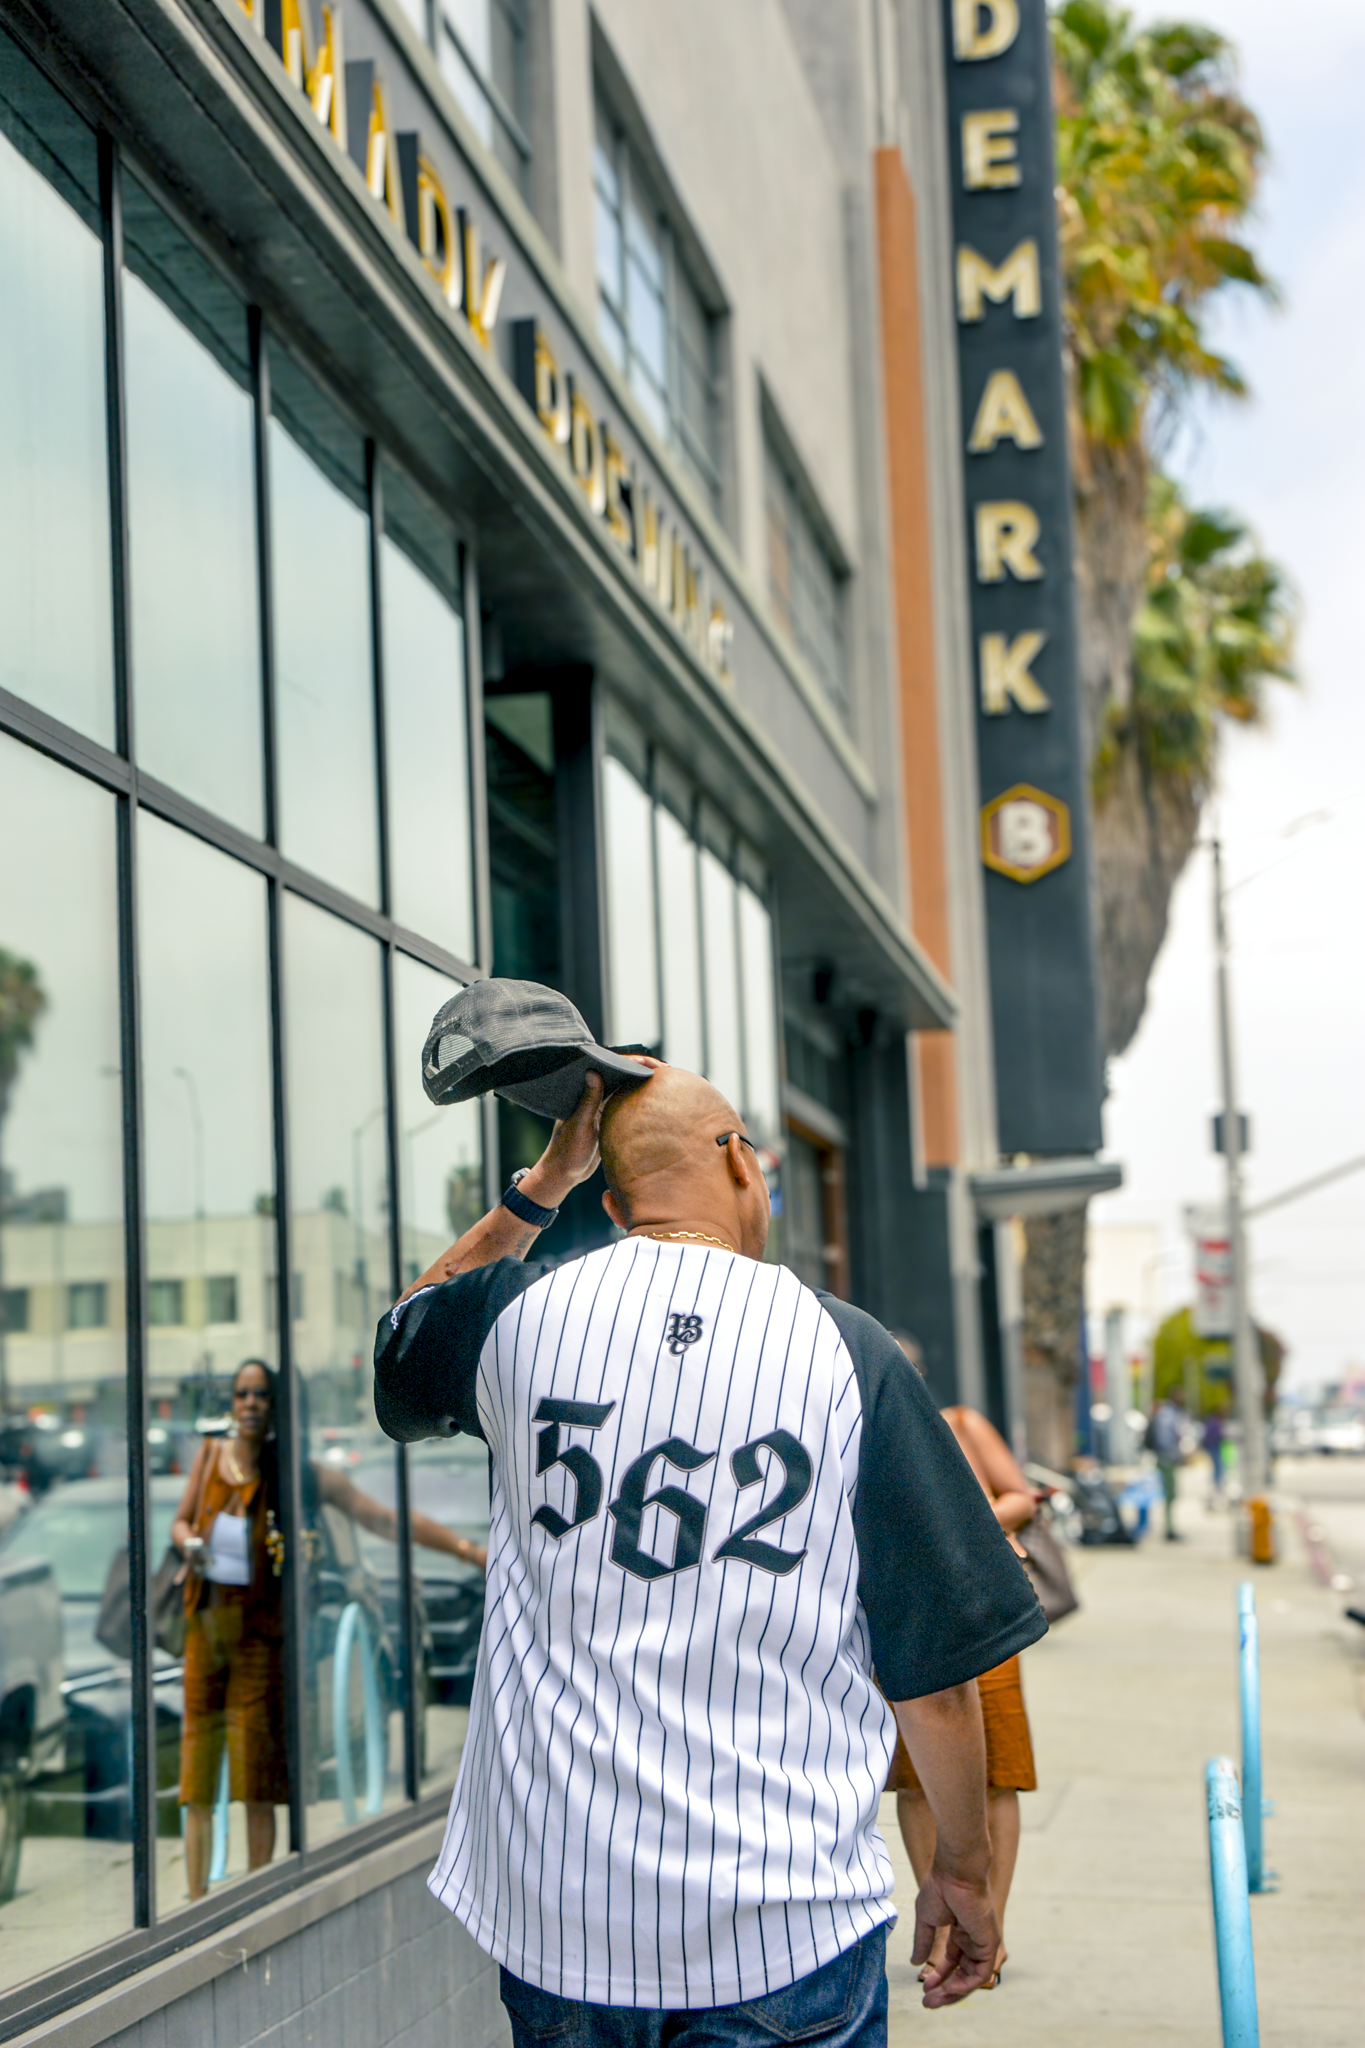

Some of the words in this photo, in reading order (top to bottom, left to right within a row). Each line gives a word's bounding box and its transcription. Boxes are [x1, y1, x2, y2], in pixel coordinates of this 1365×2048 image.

[952, 0, 1050, 716] DEMARK
[1000, 801, 1053, 867] B
[530, 1396, 814, 1583] 562
